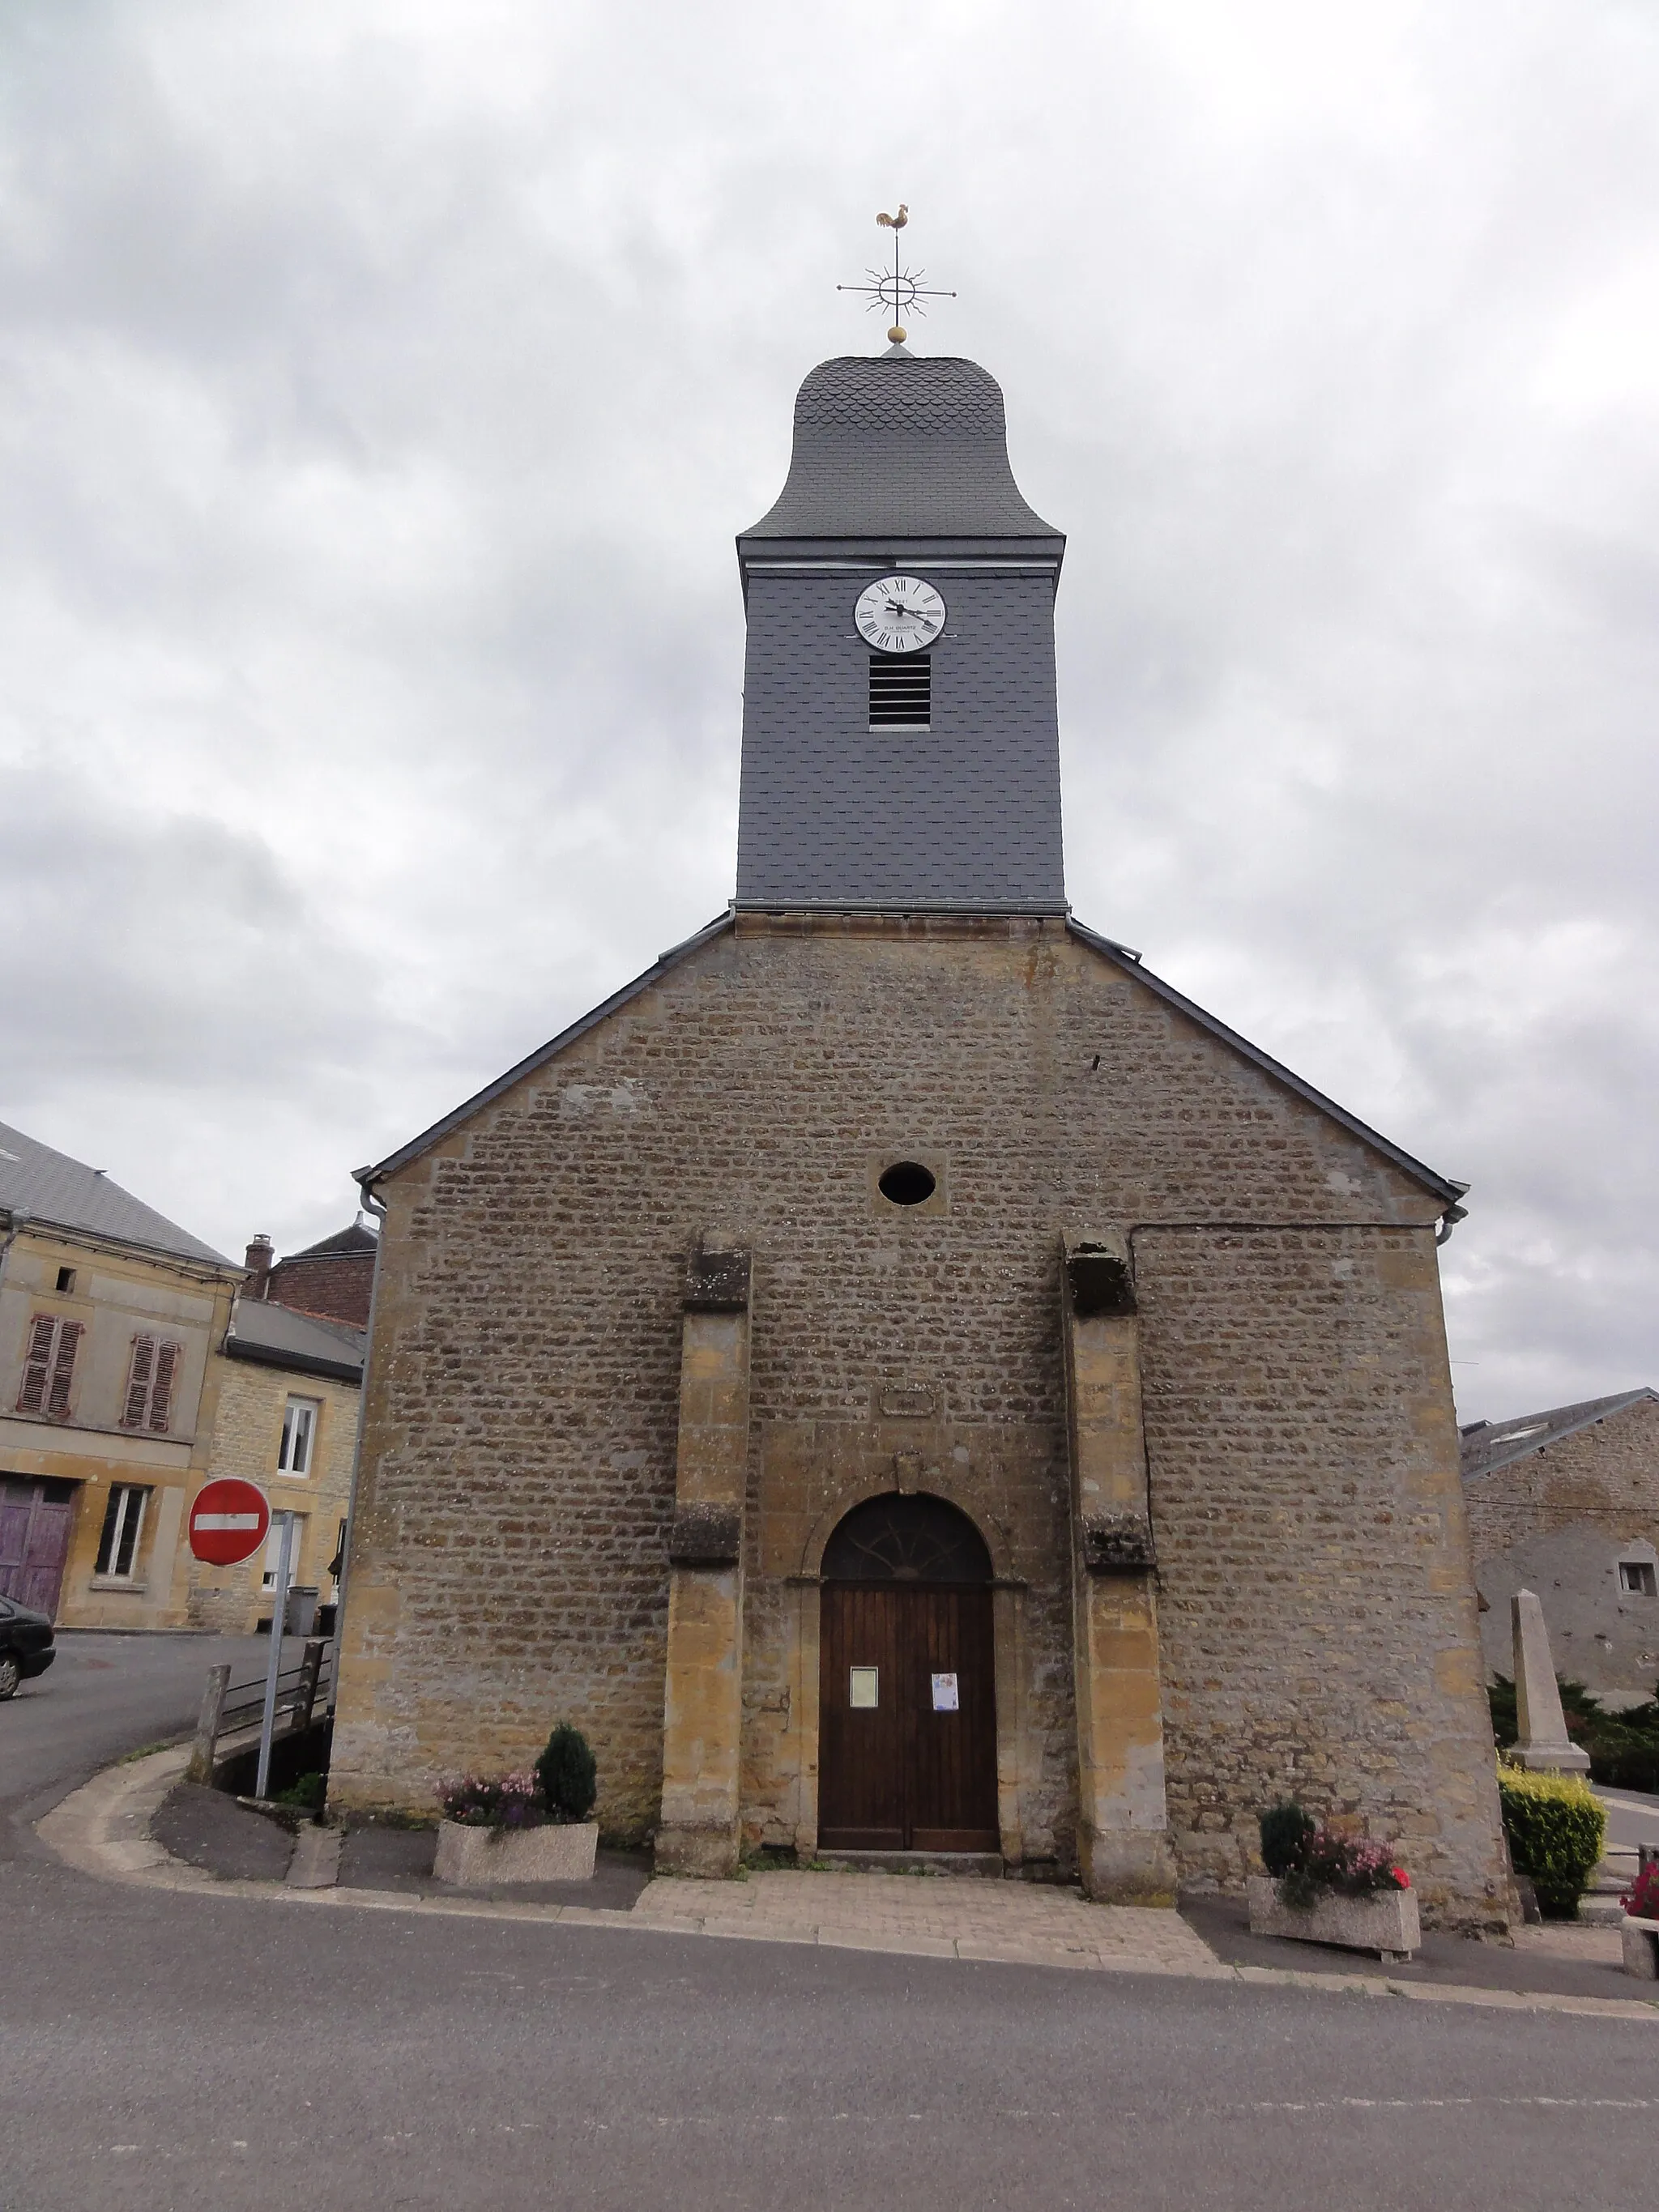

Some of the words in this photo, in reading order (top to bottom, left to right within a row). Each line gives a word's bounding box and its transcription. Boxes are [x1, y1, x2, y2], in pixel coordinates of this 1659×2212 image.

[876, 583, 889, 596] XI
[894, 580, 906, 592] XII
[913, 584, 921, 595] I
[864, 596, 878, 605] X
[922, 595, 936, 603] II
[862, 621, 879, 637] VIII
[877, 632, 891, 647] VII
[896, 636, 904, 649] VI
[914, 633, 923, 644] V
